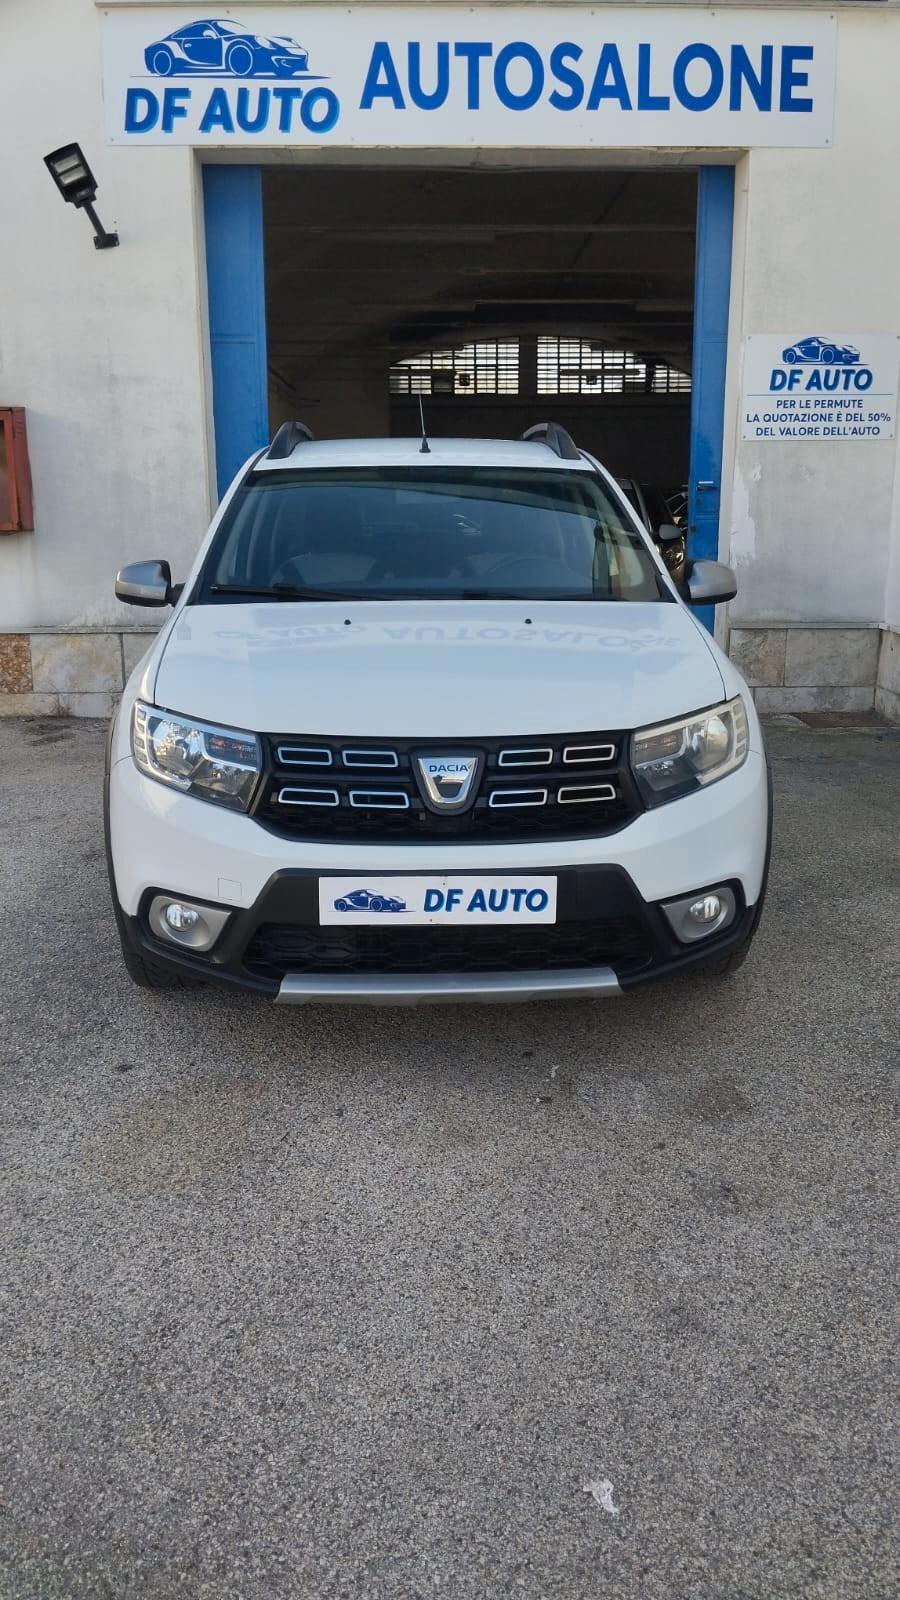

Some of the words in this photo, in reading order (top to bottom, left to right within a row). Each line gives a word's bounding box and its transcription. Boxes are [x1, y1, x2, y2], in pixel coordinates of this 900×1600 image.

[359, 41, 814, 112] AUTOSALONE
[124, 88, 192, 133] DF
[199, 87, 341, 134] AUTO
[769, 369, 803, 391] DF
[805, 369, 873, 391] AUTO
[776, 400, 796, 408] PER
[799, 400, 811, 408] LE
[814, 400, 864, 408] PERMUTE
[746, 414, 760, 422] LA
[763, 413, 833, 423] QUOTAZIONE
[836, 411, 842, 422] È
[846, 413, 865, 422] DEL
[868, 412, 891, 422] 50%
[755, 427, 775, 436] DEL
[779, 427, 820, 436] VALORE
[823, 426, 881, 436] DELL'AUTO
[429, 764, 468, 773] DACIA
[423, 888, 463, 912] DF
[467, 888, 549, 912] AUTO
